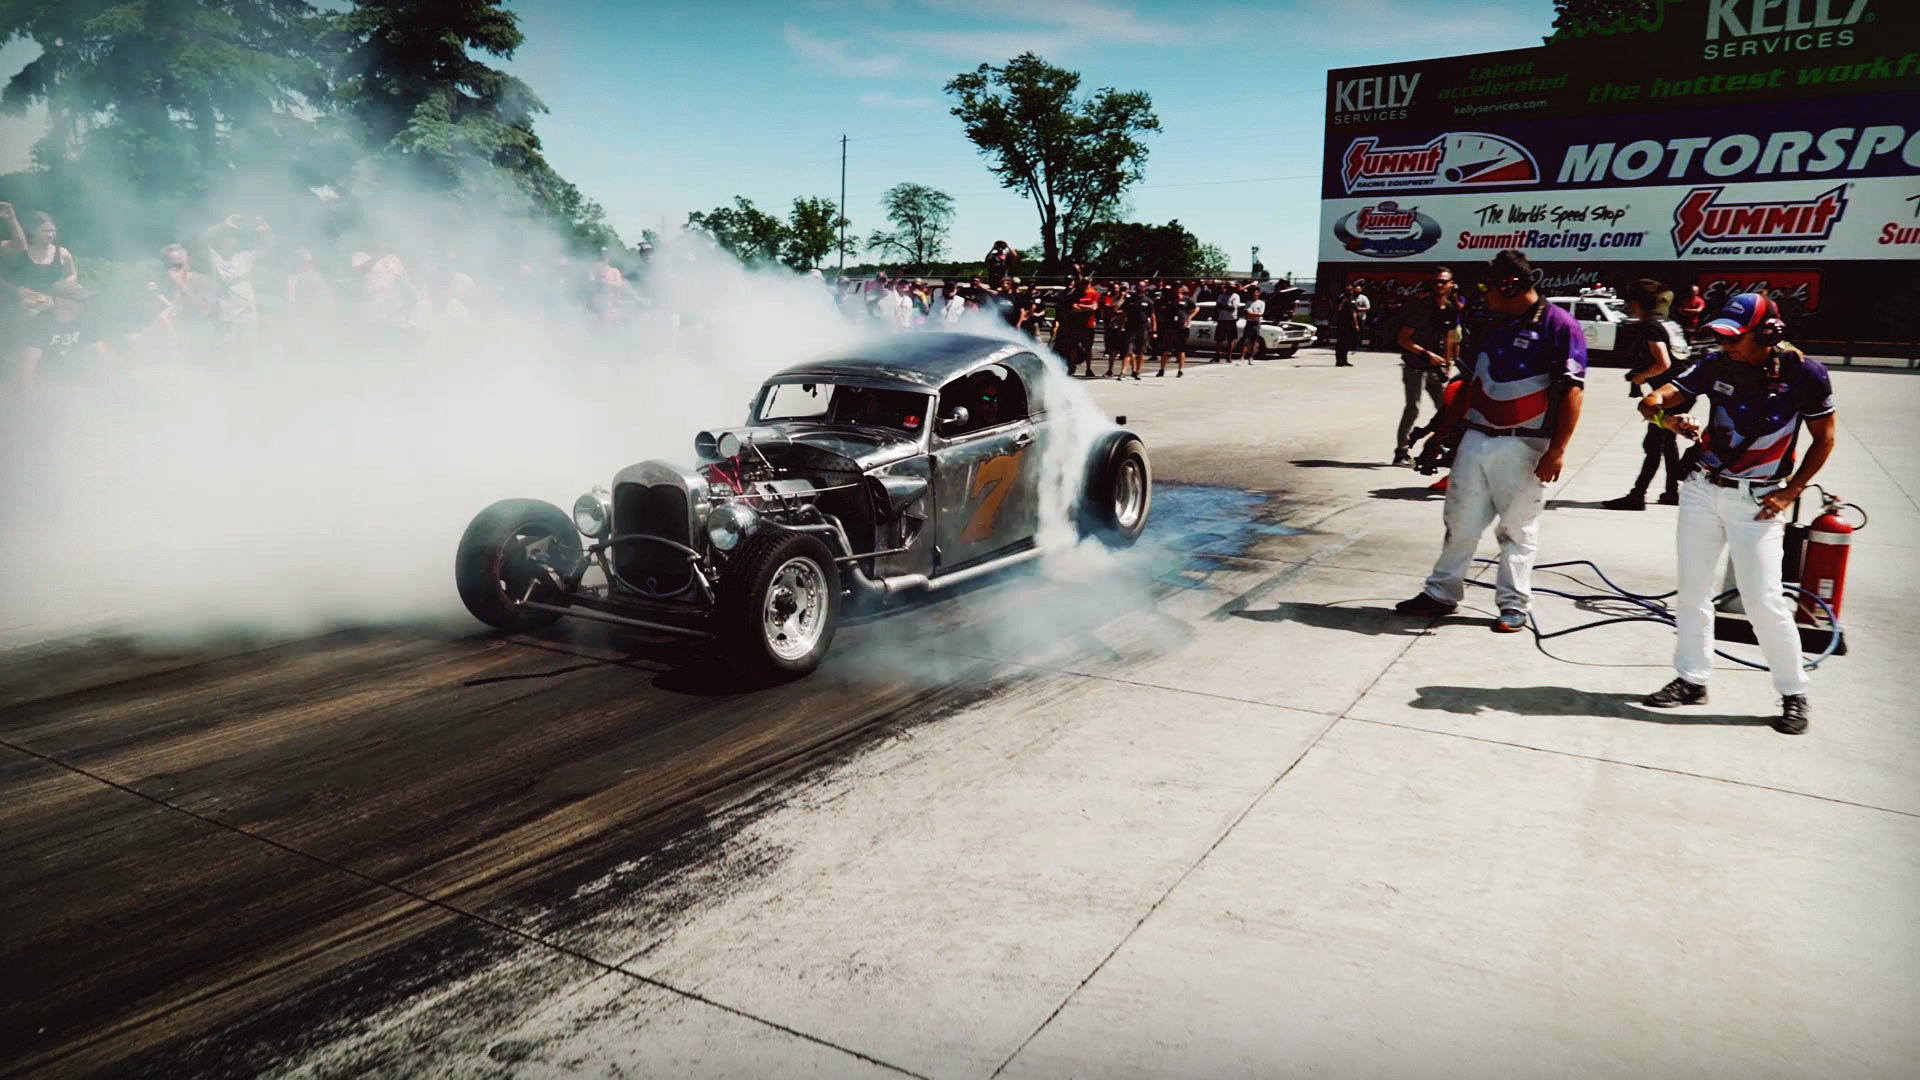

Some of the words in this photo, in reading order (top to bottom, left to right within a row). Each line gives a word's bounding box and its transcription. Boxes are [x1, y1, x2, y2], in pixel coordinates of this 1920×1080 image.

[1703, 29, 1856, 60] SERVICES
[1468, 61, 1537, 81] talent
[1335, 72, 1421, 112] KELLY
[1437, 73, 1568, 99] accelerated
[1587, 83, 1641, 104] the
[1649, 67, 1788, 99] hottest
[1334, 109, 1408, 125] SERVICES
[1454, 99, 1548, 116] kellyservices.com
[1474, 203, 1503, 227] The
[1508, 203, 1548, 223] World's
[1550, 205, 1590, 230] Speed
[1591, 205, 1626, 228] Shop
[1458, 229, 1643, 251] SummitRacing.com
[1691, 246, 1741, 256] RACING
[1744, 244, 1826, 255] EQUIPMENT
[960, 450, 1023, 544] 7
